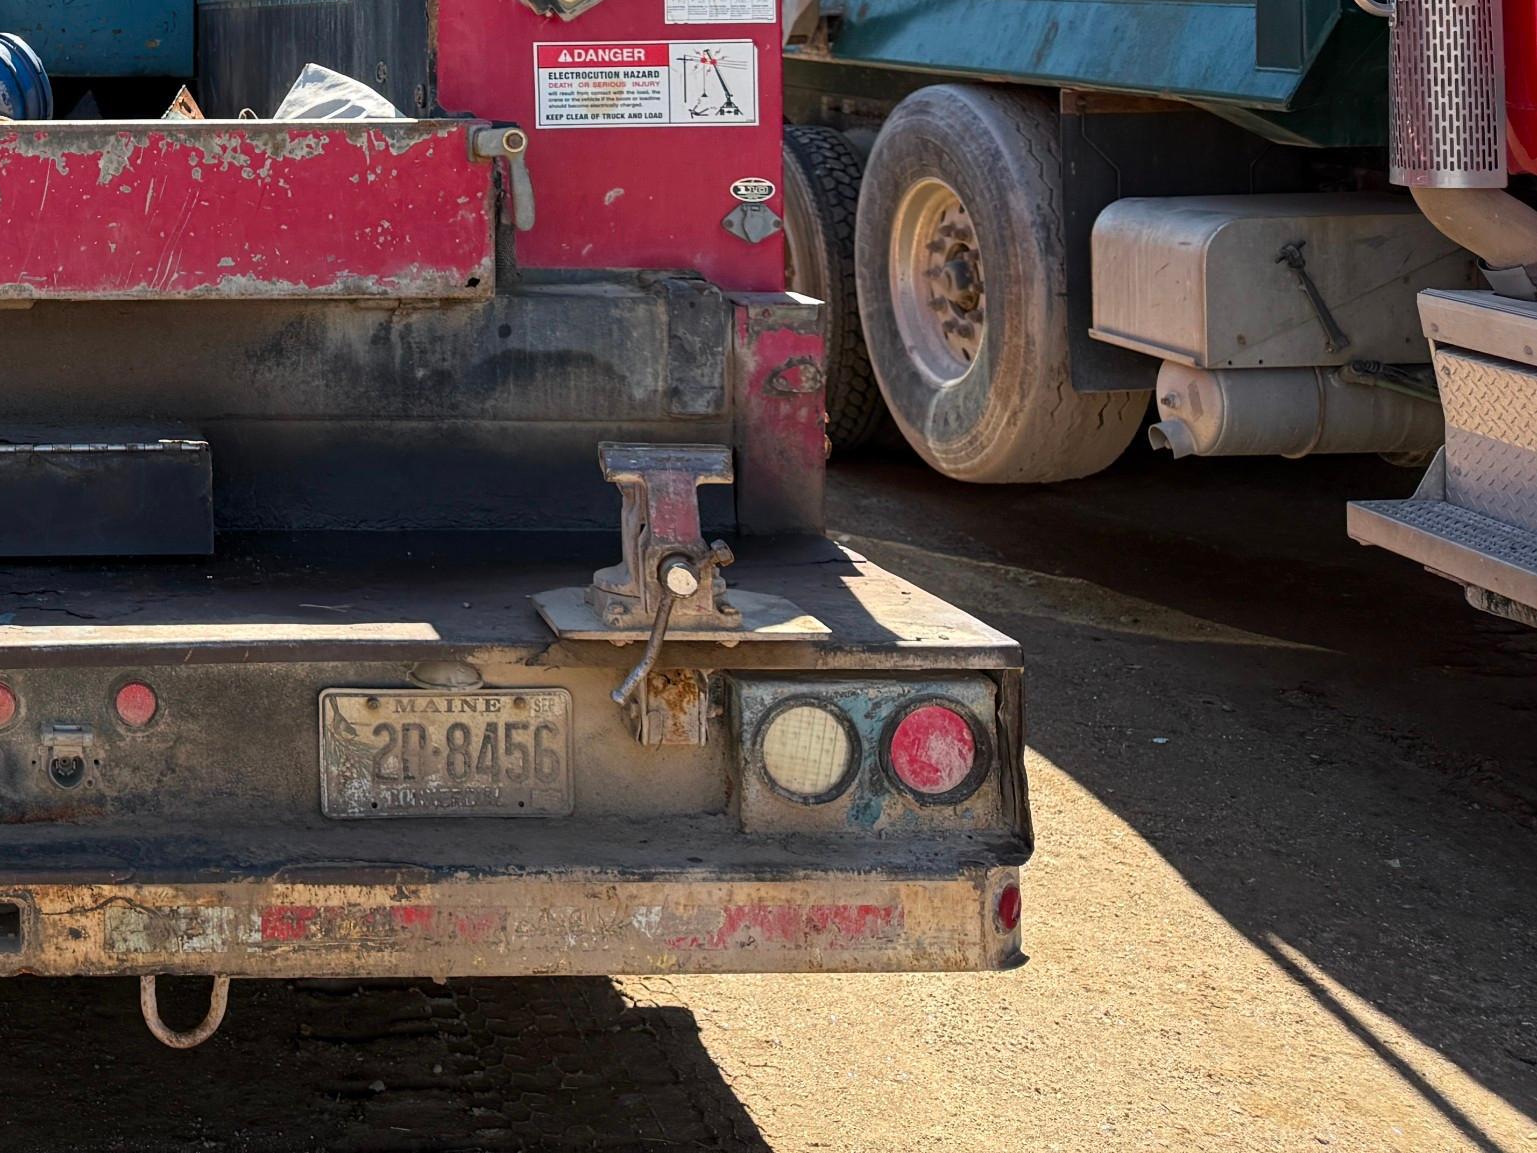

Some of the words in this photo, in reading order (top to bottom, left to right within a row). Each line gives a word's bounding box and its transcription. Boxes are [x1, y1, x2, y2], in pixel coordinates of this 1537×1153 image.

[573, 48, 646, 62] DANGER
[548, 71, 620, 80] ELECTROCUTION
[624, 70, 660, 79] HAZARD
[632, 80, 661, 88] INJURY
[546, 113, 564, 121] KEEP
[602, 112, 625, 120] TRUCK
[628, 112, 644, 120] AND
[645, 112, 663, 120] LOAD
[391, 698, 502, 714] MAINE
